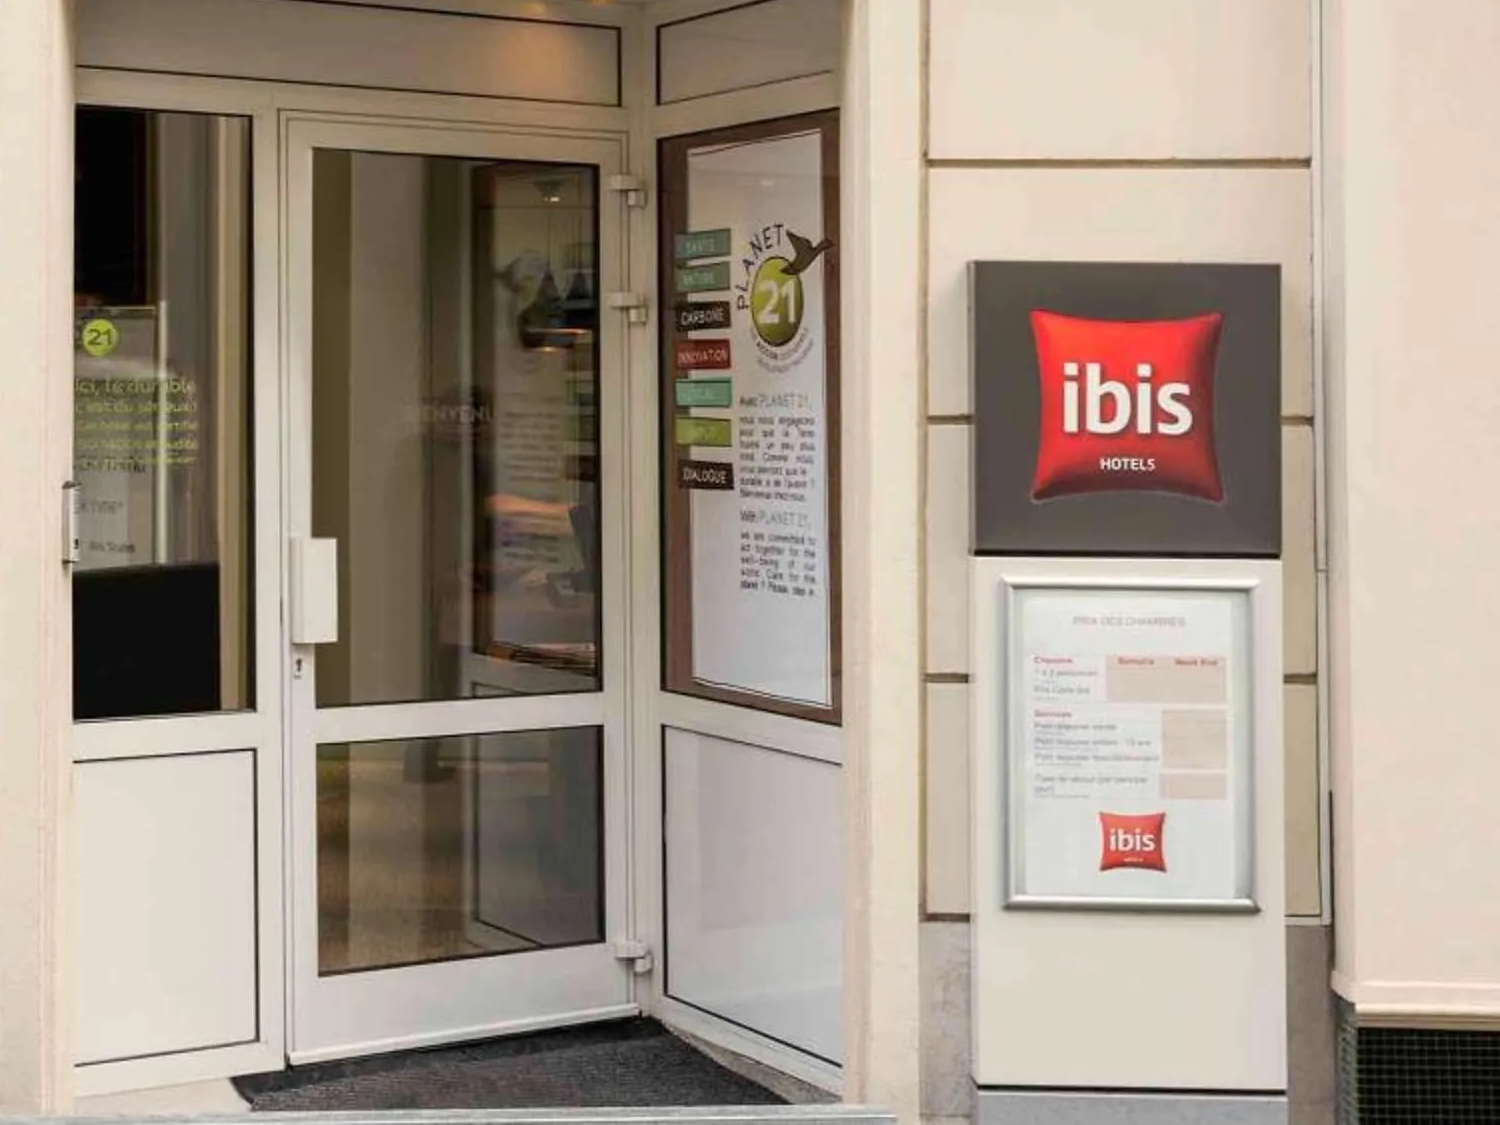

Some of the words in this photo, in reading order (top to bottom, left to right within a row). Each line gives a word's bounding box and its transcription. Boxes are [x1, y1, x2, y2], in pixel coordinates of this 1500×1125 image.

[757, 279, 797, 325] 21
[680, 307, 725, 326] CARBONE
[86, 328, 113, 346] 21
[1062, 362, 1194, 436] ibis
[1099, 457, 1156, 472] HOTELS
[682, 466, 728, 485] DIALOGUE
[1108, 827, 1157, 852] ibis
